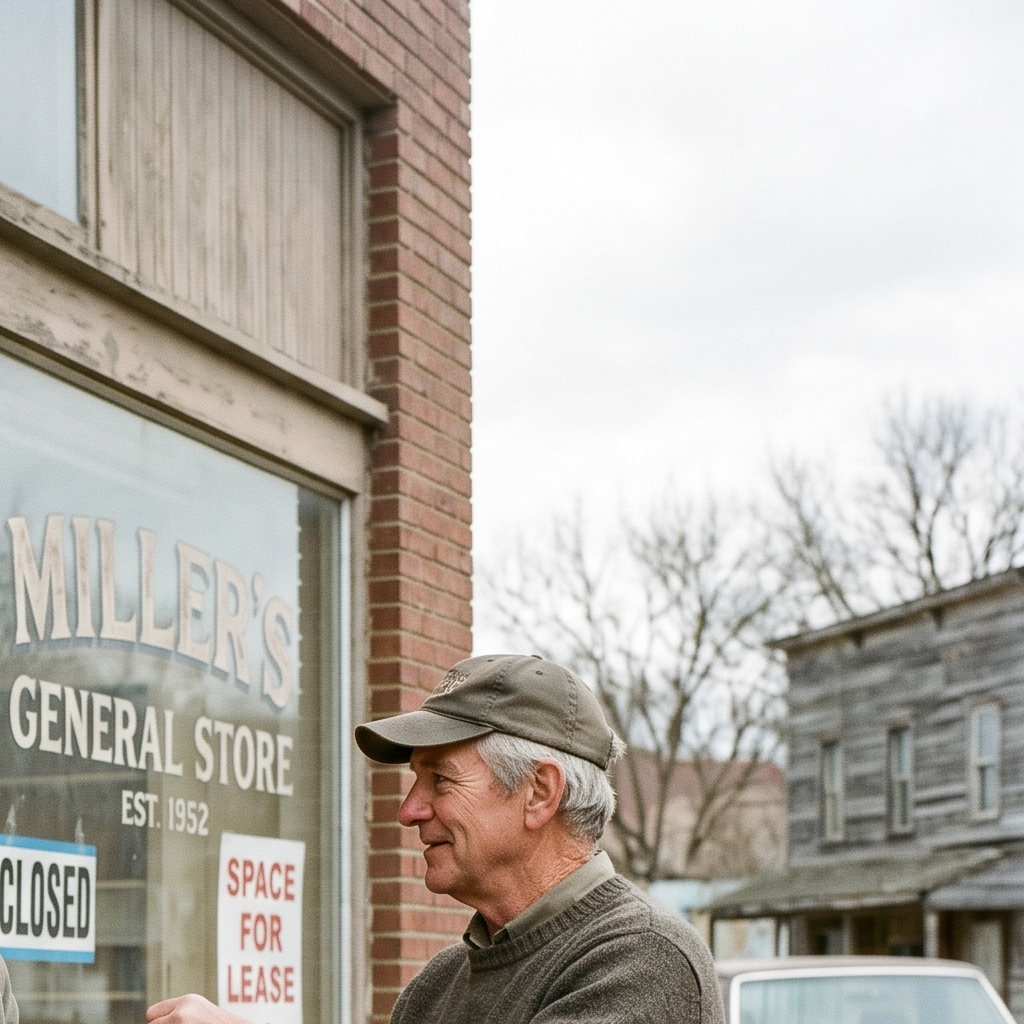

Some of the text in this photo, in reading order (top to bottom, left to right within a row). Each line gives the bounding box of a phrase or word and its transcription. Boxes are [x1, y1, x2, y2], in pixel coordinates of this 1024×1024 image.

[6, 513, 293, 710] MILLER'S
[9, 674, 294, 797] GENERAL STORE
[121, 789, 210, 837] EST. 1952
[226, 857, 296, 902] SPACE
[240, 912, 283, 953] FOR
[226, 964, 296, 1004] LEASE
